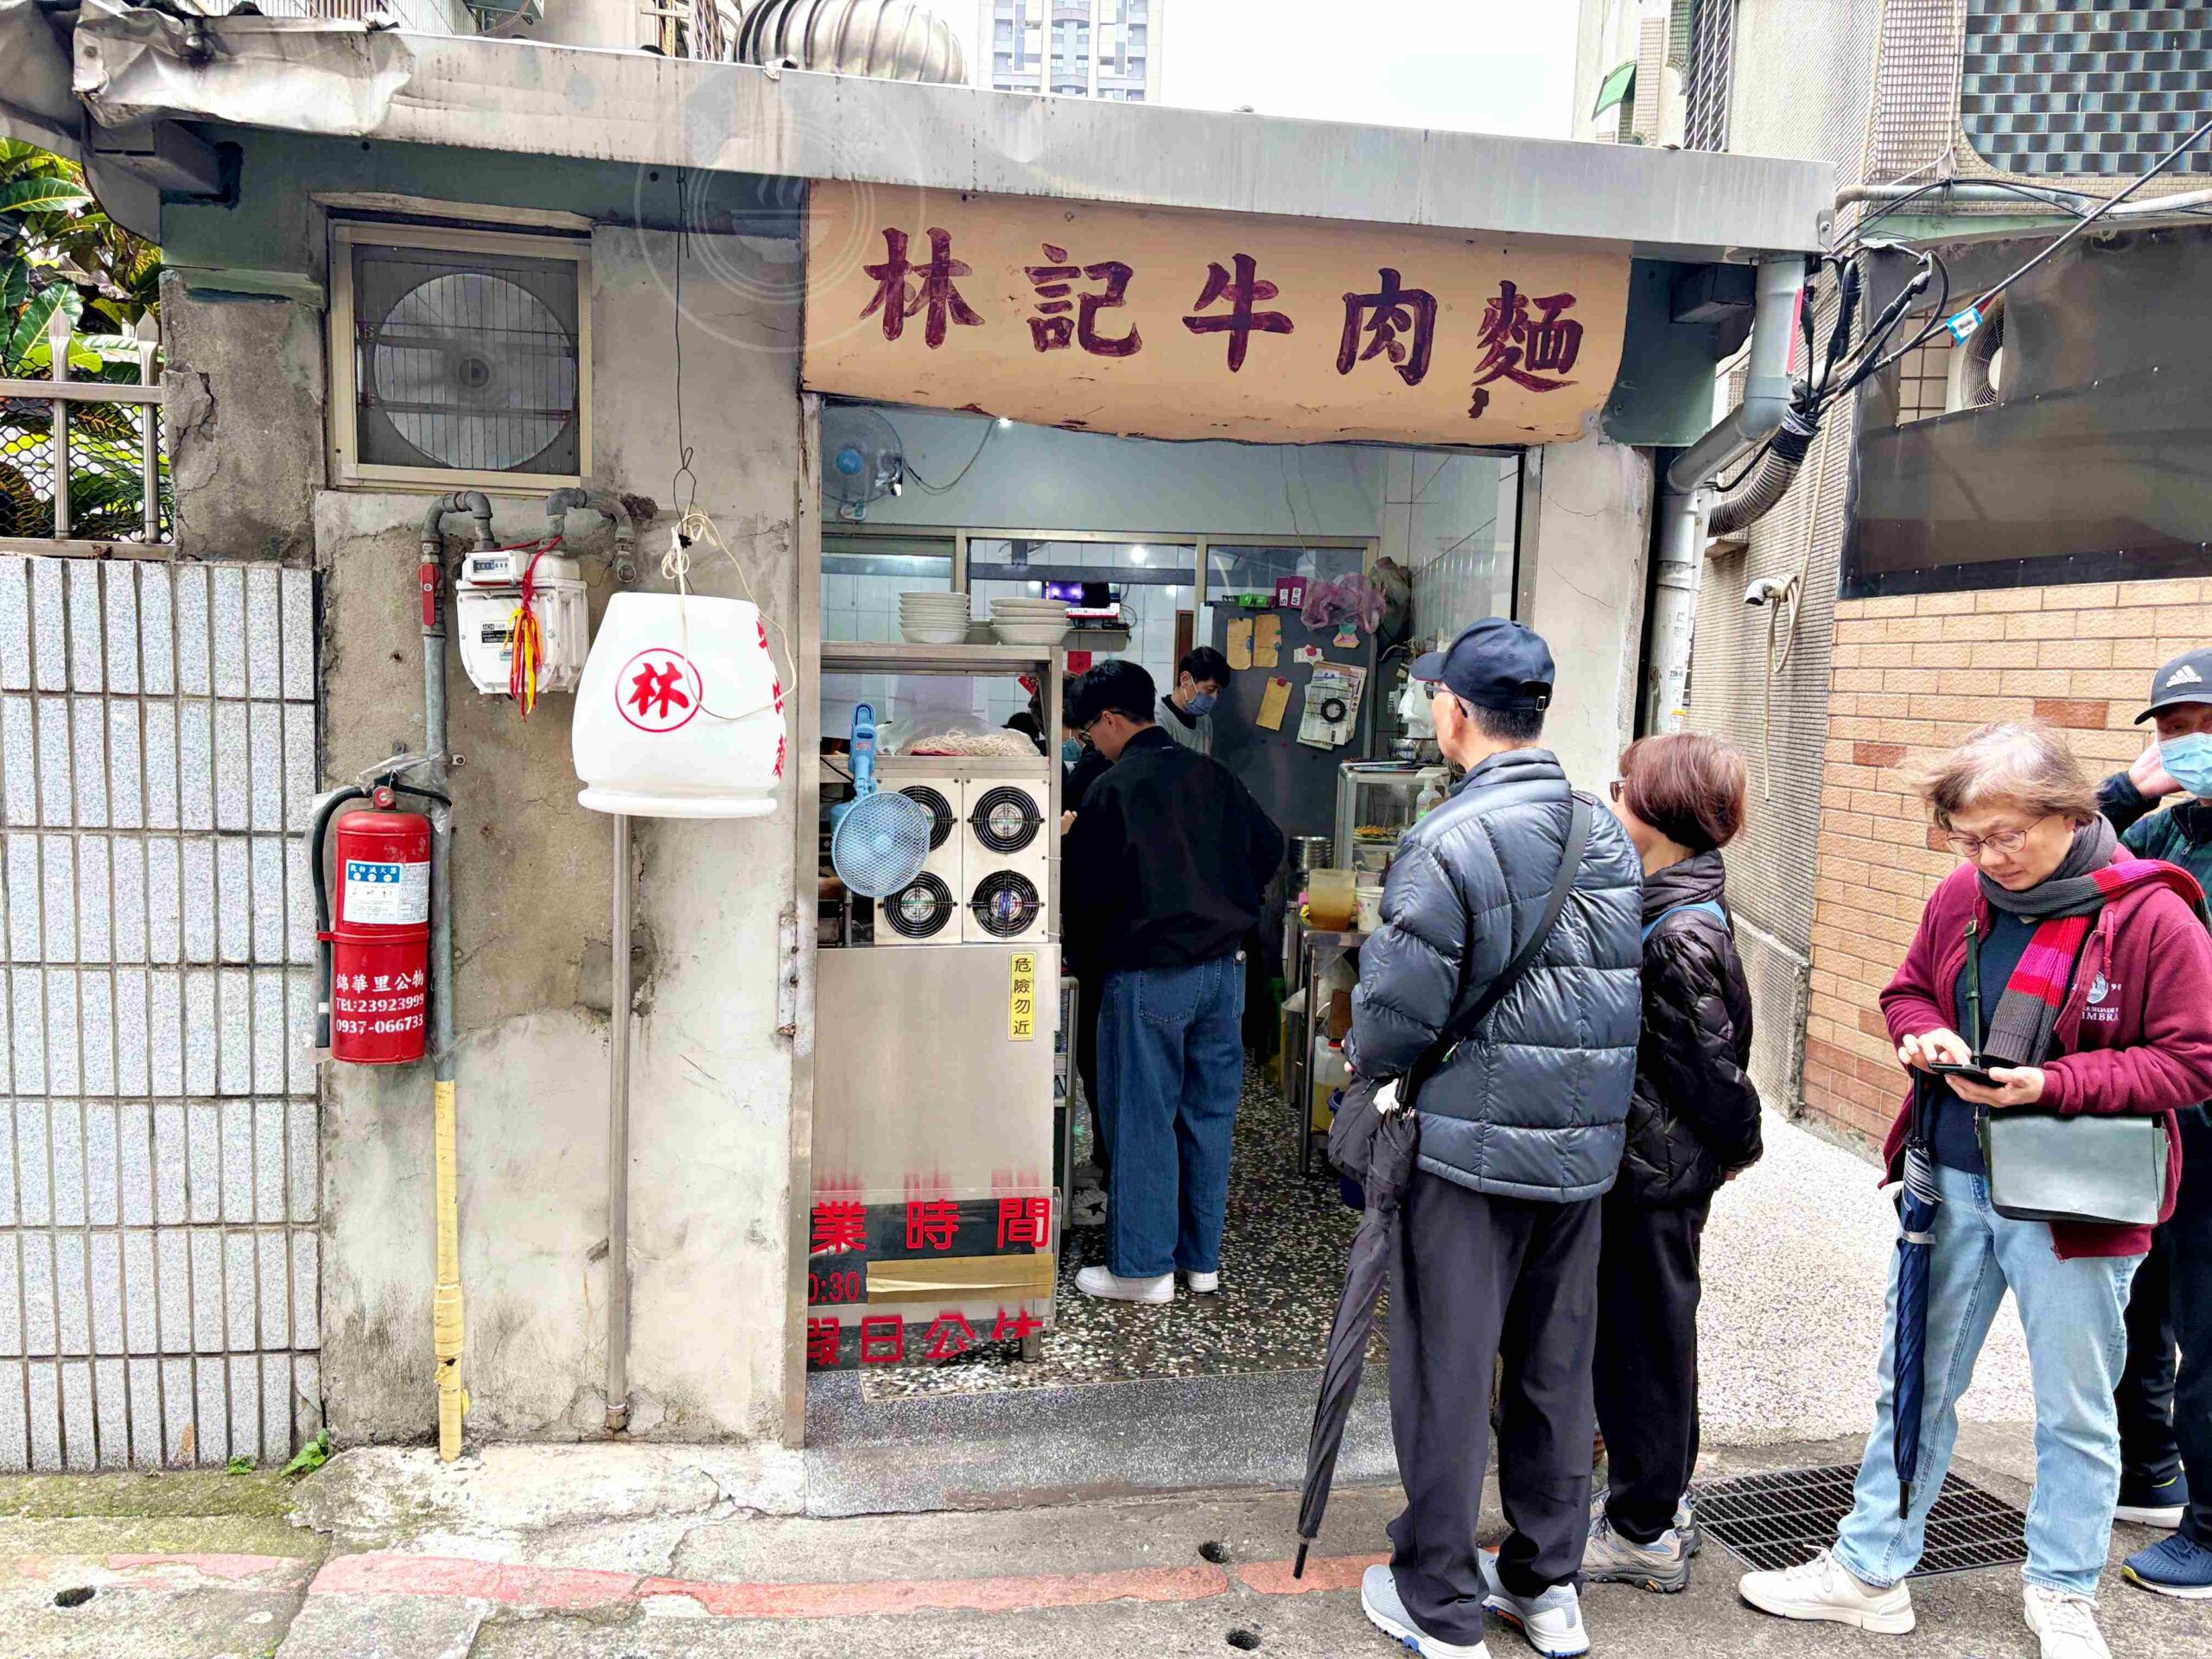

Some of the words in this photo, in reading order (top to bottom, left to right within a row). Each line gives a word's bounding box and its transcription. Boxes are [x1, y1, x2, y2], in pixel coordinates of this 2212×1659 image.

[860, 226, 1584, 393] 林記牛肉麵
[627, 661, 690, 719] 林
[335, 993, 424, 1013] TEL:23923999
[336, 969, 424, 995] 錦華里公物
[1014, 957, 1032, 1035] 危險勿近
[335, 1014, 423, 1035] 0937-066733
